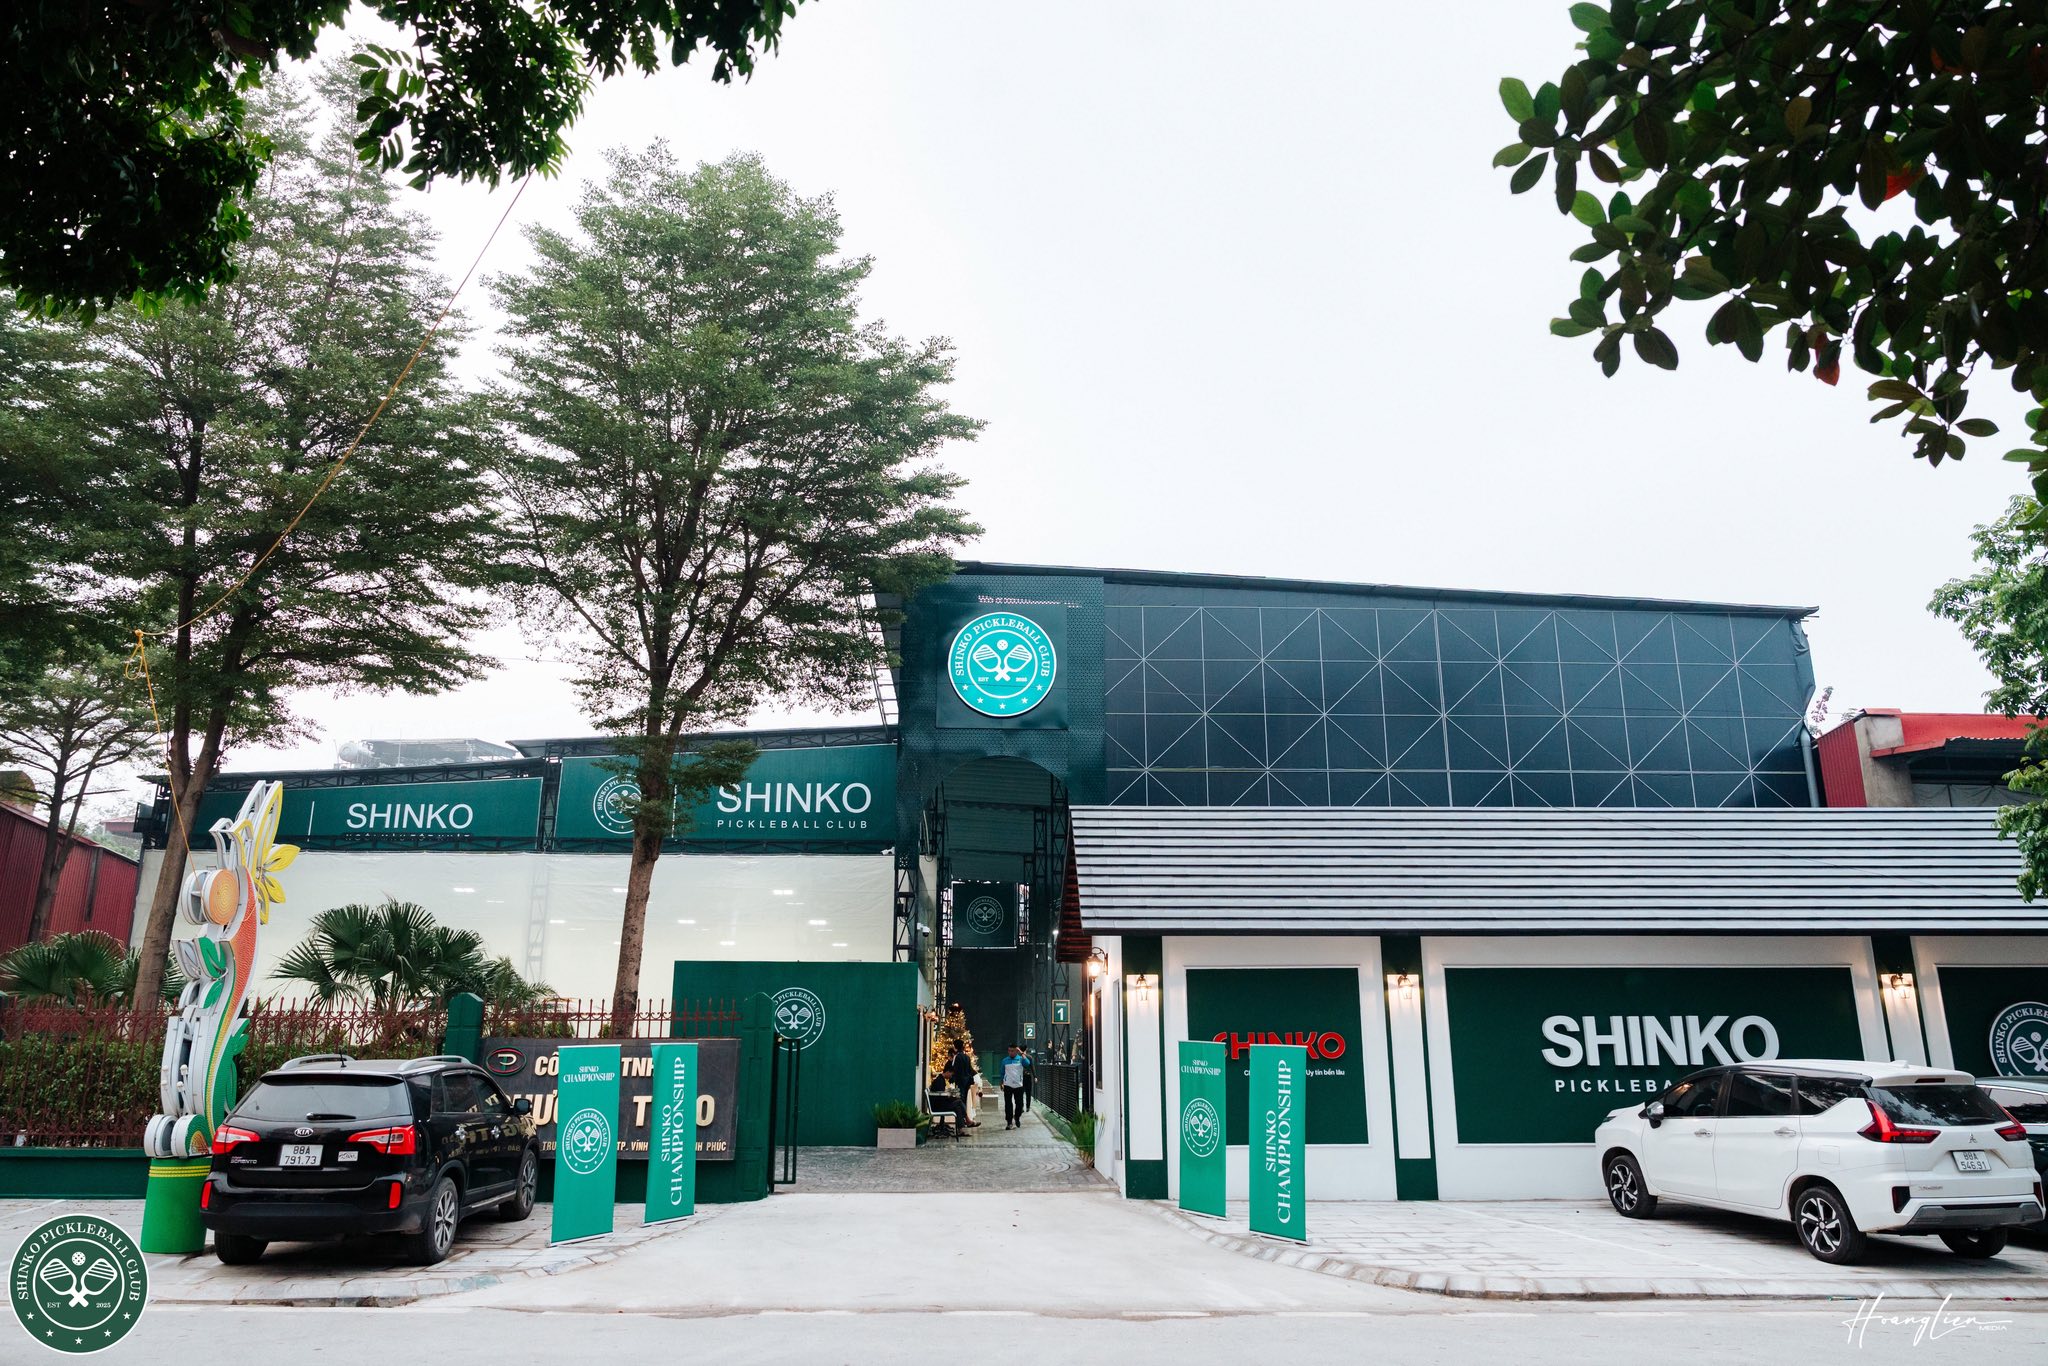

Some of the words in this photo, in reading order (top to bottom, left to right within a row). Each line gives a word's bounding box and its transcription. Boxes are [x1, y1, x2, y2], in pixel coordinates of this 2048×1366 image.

[954, 632, 973, 676] SHINKO
[973, 618, 1040, 644] PICKLEBALL
[1038, 645, 1050, 677] CLUB
[717, 782, 872, 814] SHINKO
[346, 803, 474, 829] SHINKO
[717, 820, 820, 828] PICKLEBALL
[826, 820, 867, 829] CLUB
[778, 991, 817, 1008] PICKLEBALL
[1057, 1007, 1064, 1020] 1
[1027, 1028, 1033, 1036] 2
[1541, 1015, 1780, 1067] SHINKO
[1995, 1022, 2009, 1063] SHINKO
[534, 1051, 559, 1076] CÔ
[1181, 1065, 1221, 1075] CHAMPIONSHIP
[563, 1072, 615, 1083] CHAMPIONSHIP
[1555, 1080, 1673, 1092] PICKLEBA
[661, 1104, 672, 1162] SHINKO
[670, 1056, 685, 1205] CHAMPIONSHIP
[706, 1138, 726, 1151] PHÚC
[1265, 1110, 1277, 1173] SHINKO
[1277, 1060, 1291, 1224] CHAMPIONSHIP
[293, 1146, 311, 1155] 88A
[1963, 1152, 1978, 1160] 88A
[285, 1155, 317, 1164] 791.73
[1961, 1161, 1986, 1169] 546.91
